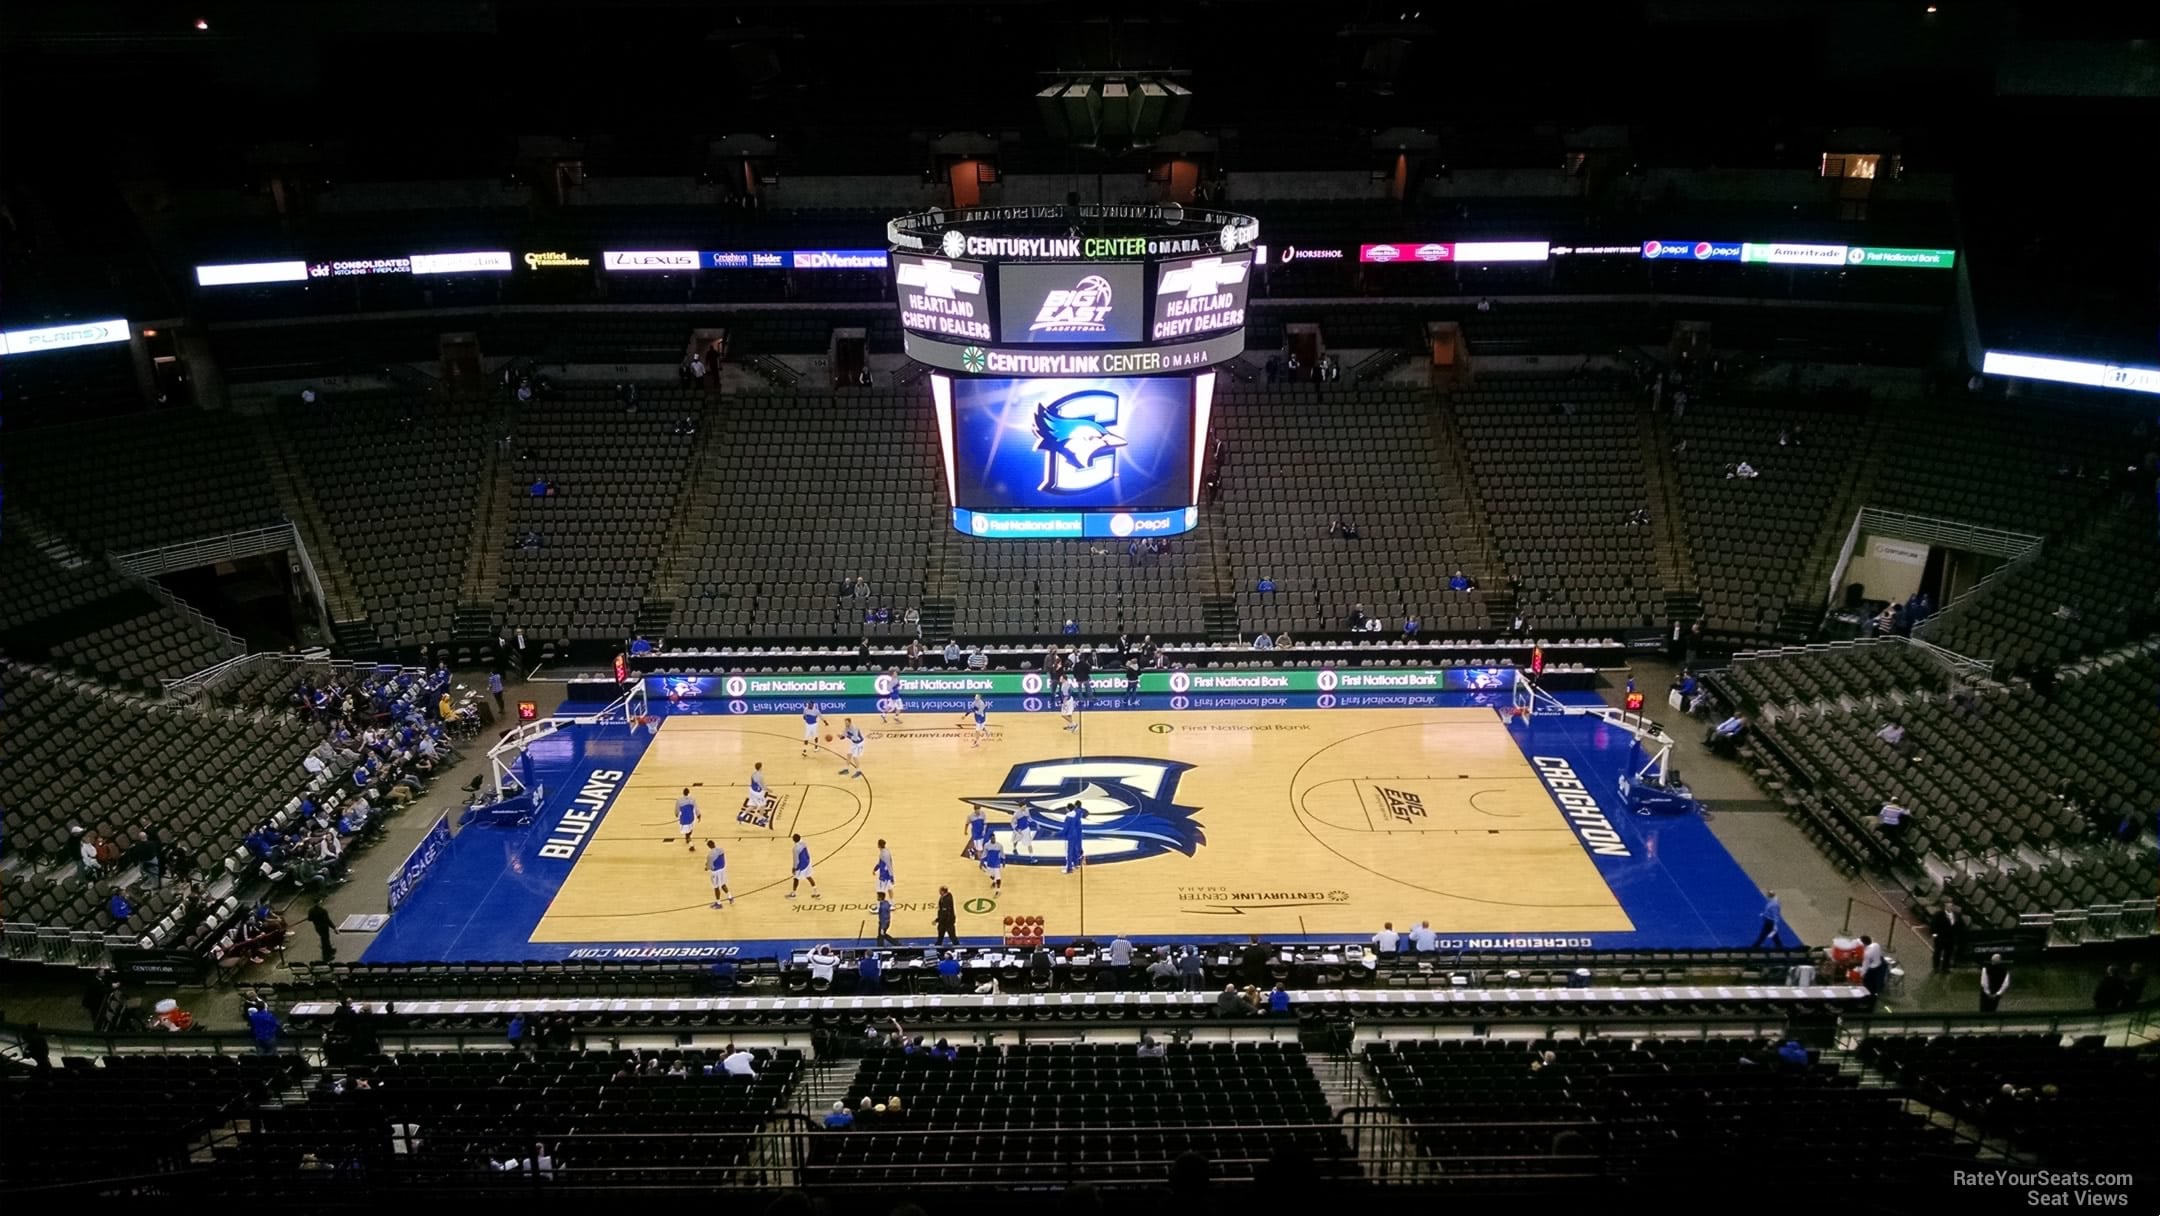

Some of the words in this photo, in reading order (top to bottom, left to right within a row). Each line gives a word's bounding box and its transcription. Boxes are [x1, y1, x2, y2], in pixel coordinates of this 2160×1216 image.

[967, 236, 1080, 257] CENTURYLINK
[1085, 238, 1146, 257] CENTER
[1148, 239, 1200, 254] OMAHA
[1661, 246, 1688, 255] pepsi
[1712, 247, 1739, 256] pepsi
[1774, 248, 1841, 257] Ameritrade
[525, 252, 567, 265] Certified
[713, 253, 748, 263] Creighton
[811, 252, 888, 267] DiVentures
[1296, 250, 1343, 258] HORSESHOE
[1885, 253, 1918, 262] National
[1919, 253, 1940, 262] Bank
[333, 259, 410, 270] CONSOLIDATED
[634, 256, 692, 265] LEXUS
[1043, 290, 1098, 307] BIG
[909, 294, 974, 317] HEARTLAND
[1167, 293, 1233, 317] HEARTLAND
[1035, 306, 1112, 322] EAST
[902, 311, 937, 330] CHEVY
[939, 316, 991, 339] DEALERS
[1154, 318, 1193, 338] CHEVY
[1194, 309, 1244, 331] DEALERS
[29, 328, 94, 344] PLAINS
[987, 352, 1101, 374] CENTURYLINK
[1103, 352, 1160, 372] CENTER
[1163, 351, 1208, 369] OMAHA
[1010, 521, 1053, 531] National
[1055, 521, 1082, 531] Bank
[1135, 517, 1169, 533] pepsi
[751, 680, 771, 692] First
[772, 680, 817, 692] National
[819, 680, 845, 692] Bank
[900, 680, 918, 691] First
[919, 680, 965, 691] National
[967, 679, 993, 691] Bank
[1194, 678, 1212, 688] First
[1214, 677, 1260, 688] National
[1262, 677, 1288, 687] Bank
[1342, 675, 1360, 686] First
[1362, 675, 1407, 686] National
[1409, 675, 1436, 686] Bank
[1384, 788, 1413, 824] EAST
[1402, 792, 1428, 817] BIG
[1533, 756, 1632, 856] CREIGHTON
[538, 769, 623, 859] BLUEJAYS
[1232, 892, 1325, 900] CENTURYLINK
[792, 903, 835, 912] Bank
[568, 946, 739, 958] GOCREIGHTON.COM
